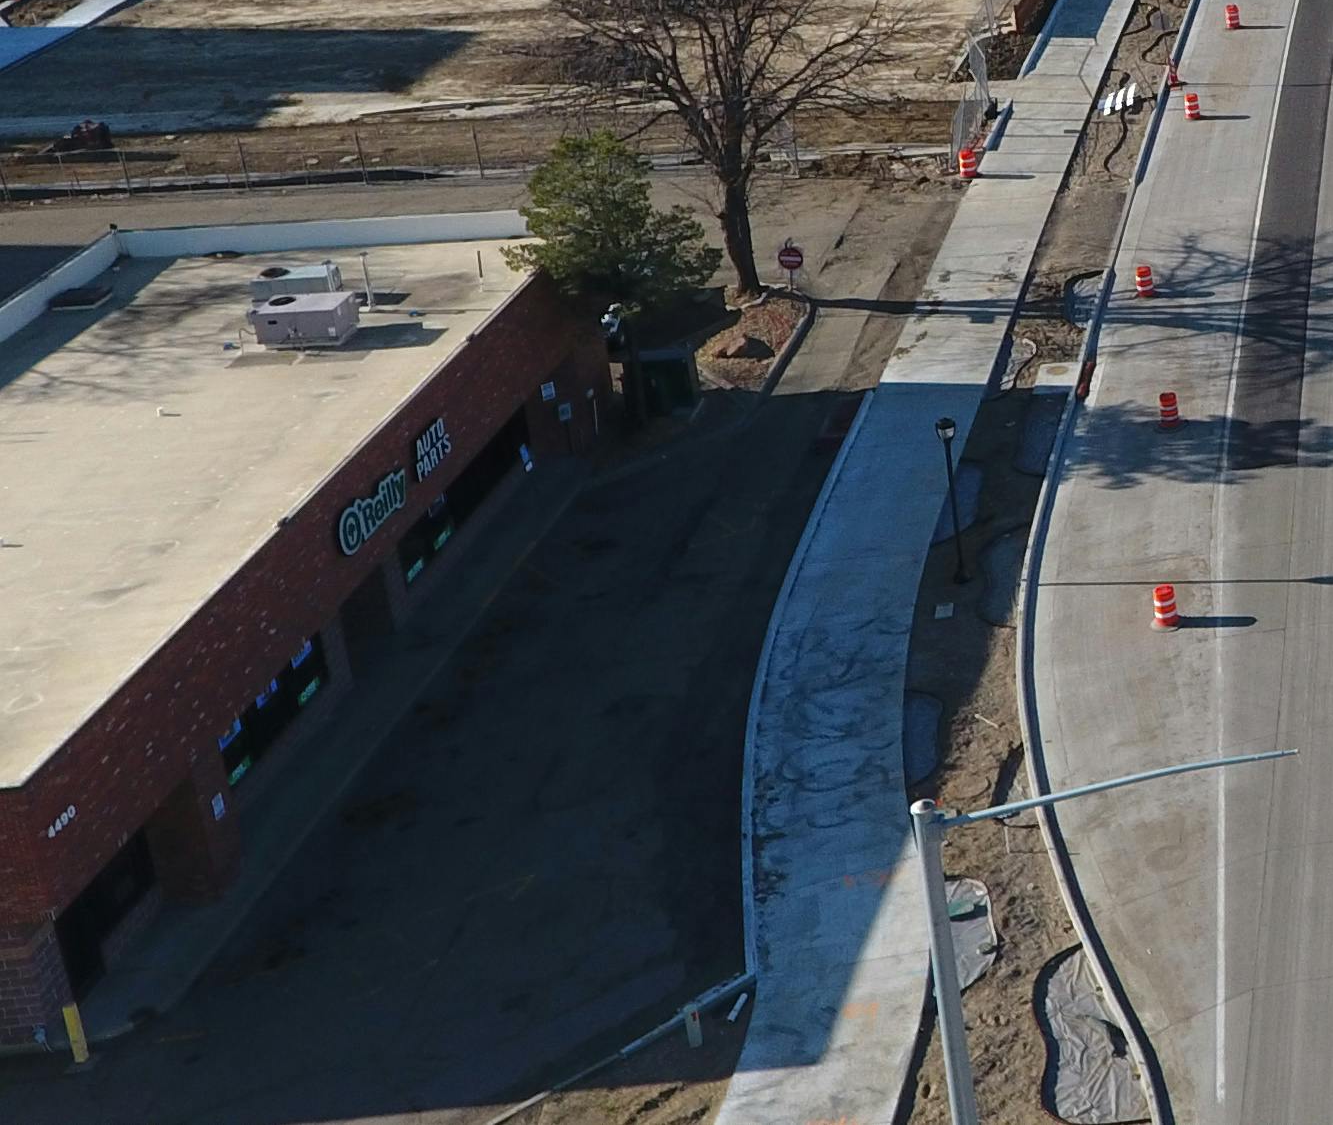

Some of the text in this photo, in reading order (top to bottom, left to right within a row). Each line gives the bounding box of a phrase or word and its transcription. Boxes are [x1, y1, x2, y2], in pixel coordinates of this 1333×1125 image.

[416, 417, 445, 461] AUTO
[416, 433, 452, 483] PARTS
[338, 467, 407, 556] O'Reilly
[47, 804, 76, 839] 4490
